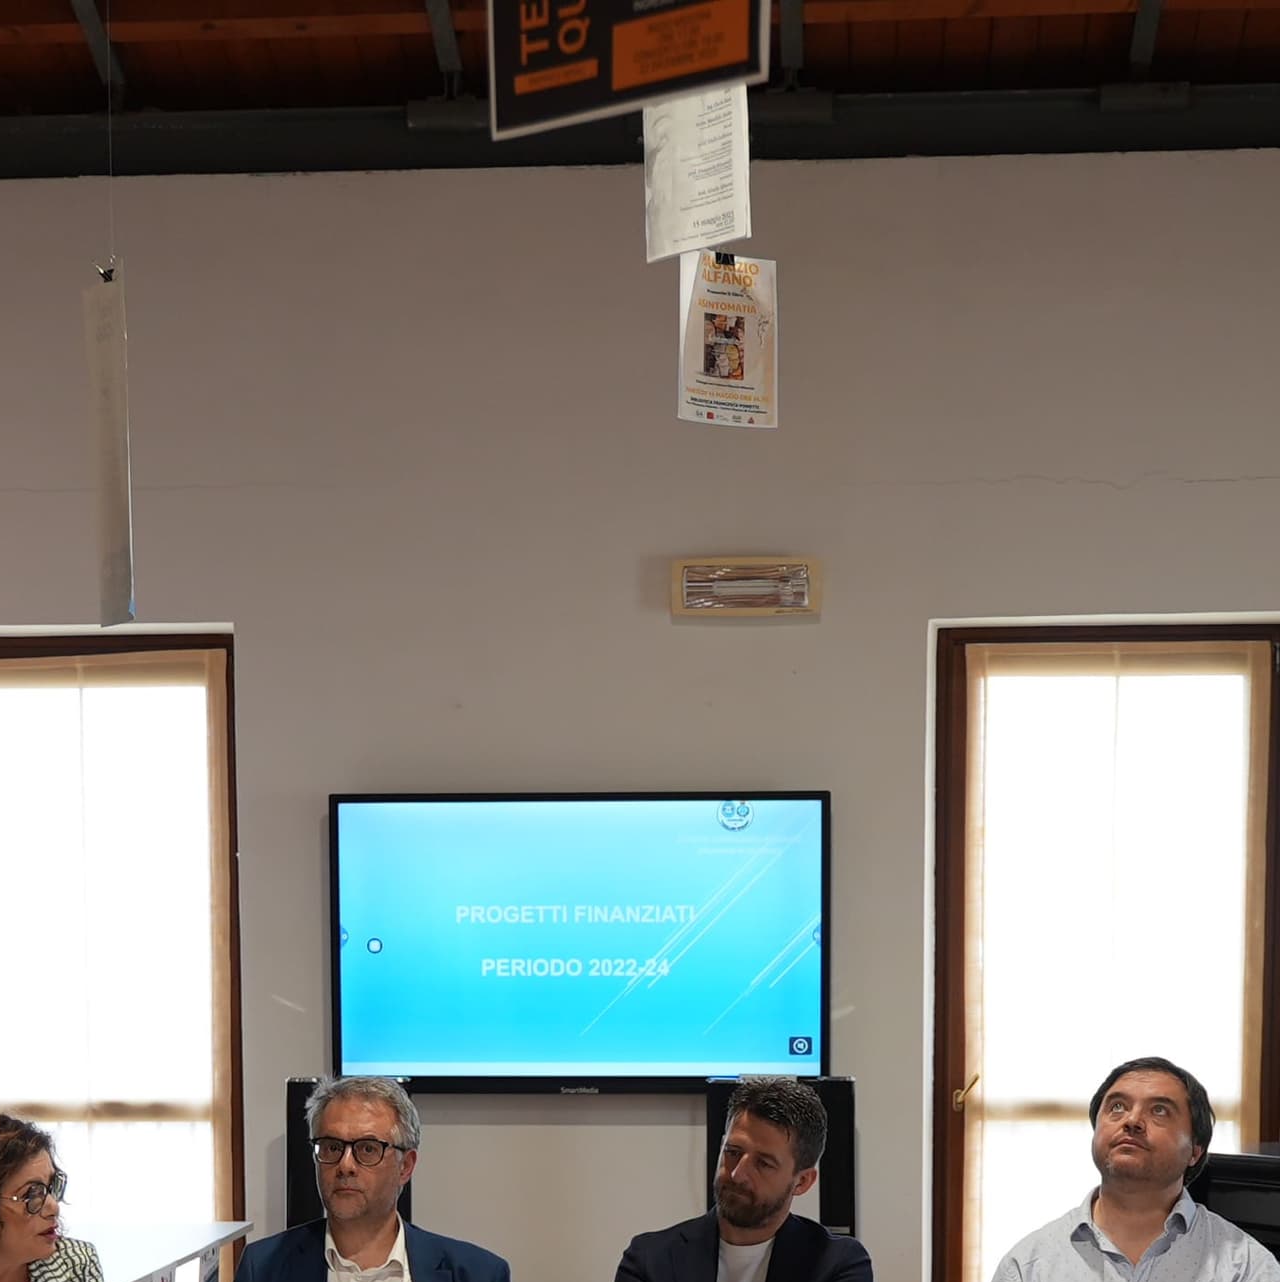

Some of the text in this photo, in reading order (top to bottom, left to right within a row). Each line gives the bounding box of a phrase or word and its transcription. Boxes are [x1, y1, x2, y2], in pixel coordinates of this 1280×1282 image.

[455, 905, 697, 924] PROGETTI FINANZIATI
[481, 958, 670, 978] PERIODO 2022-24
